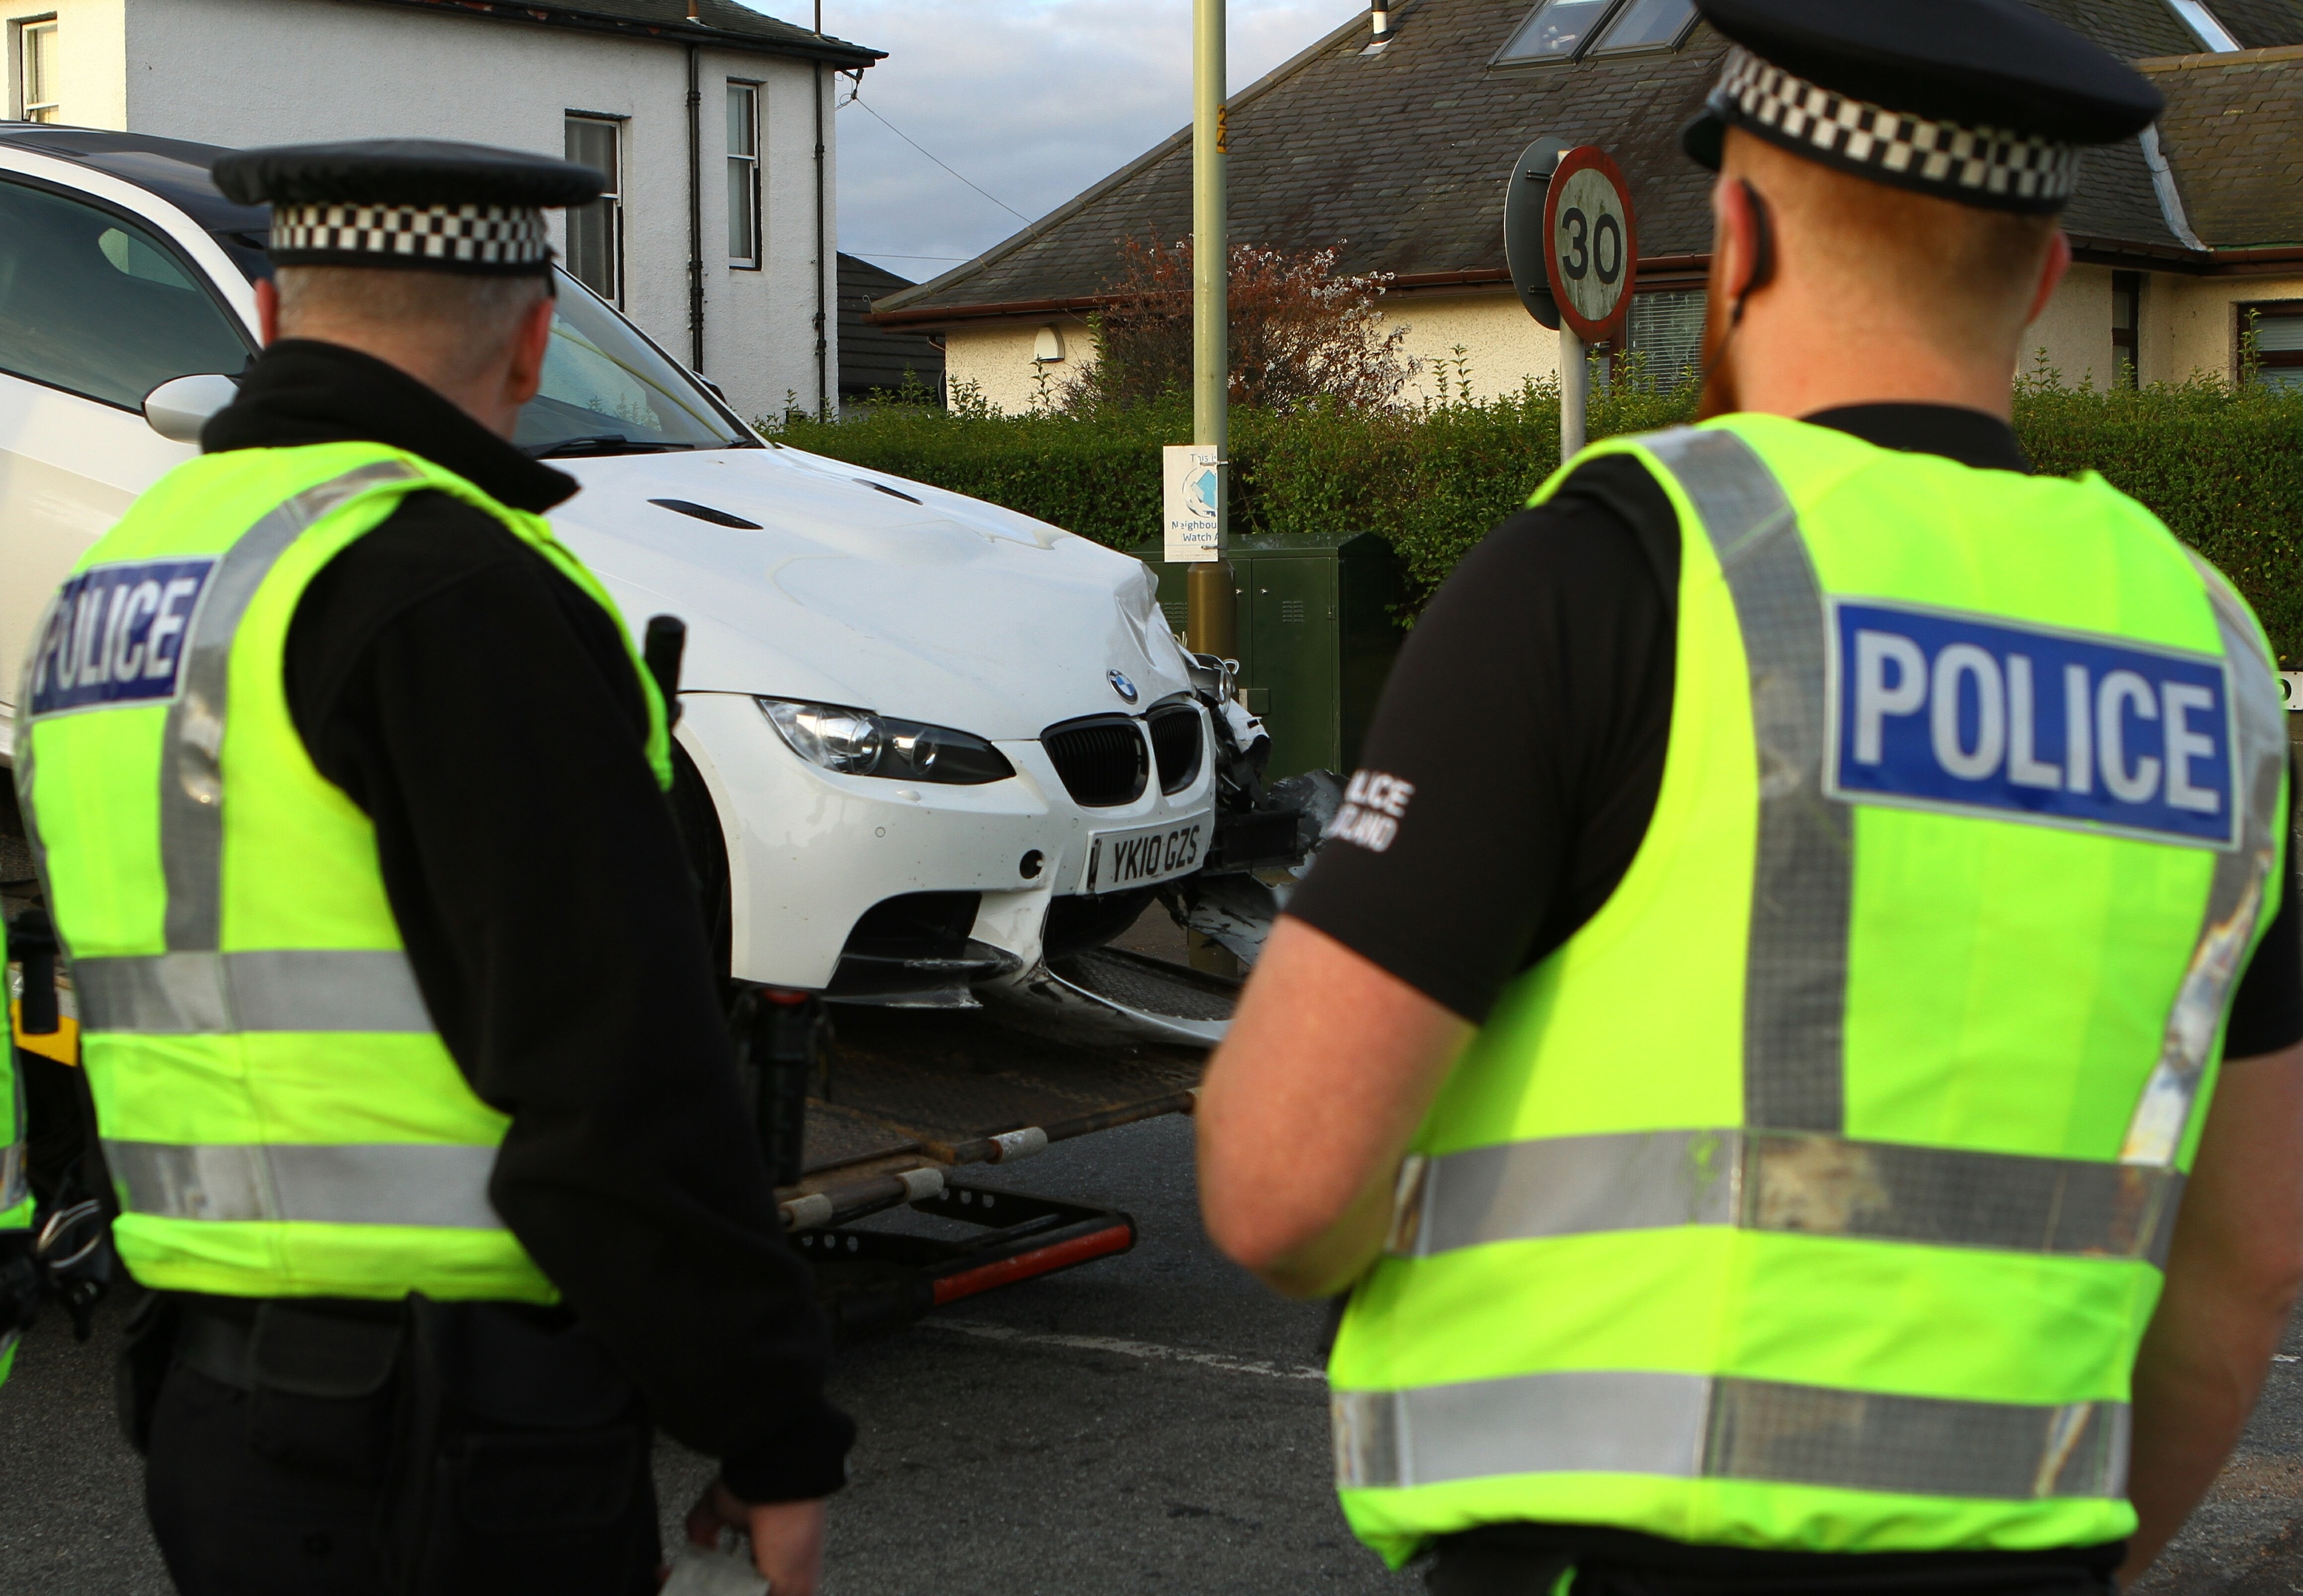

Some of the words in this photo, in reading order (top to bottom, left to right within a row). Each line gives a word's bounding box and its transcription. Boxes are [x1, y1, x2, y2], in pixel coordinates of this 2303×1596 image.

[1562, 207, 1622, 285] 30
[1183, 533, 1212, 542] Watch
[33, 576, 198, 697] POLICE
[1853, 629, 2220, 814] POLICE
[1114, 835, 1162, 883] YK10
[1164, 825, 1200, 872] GZS
